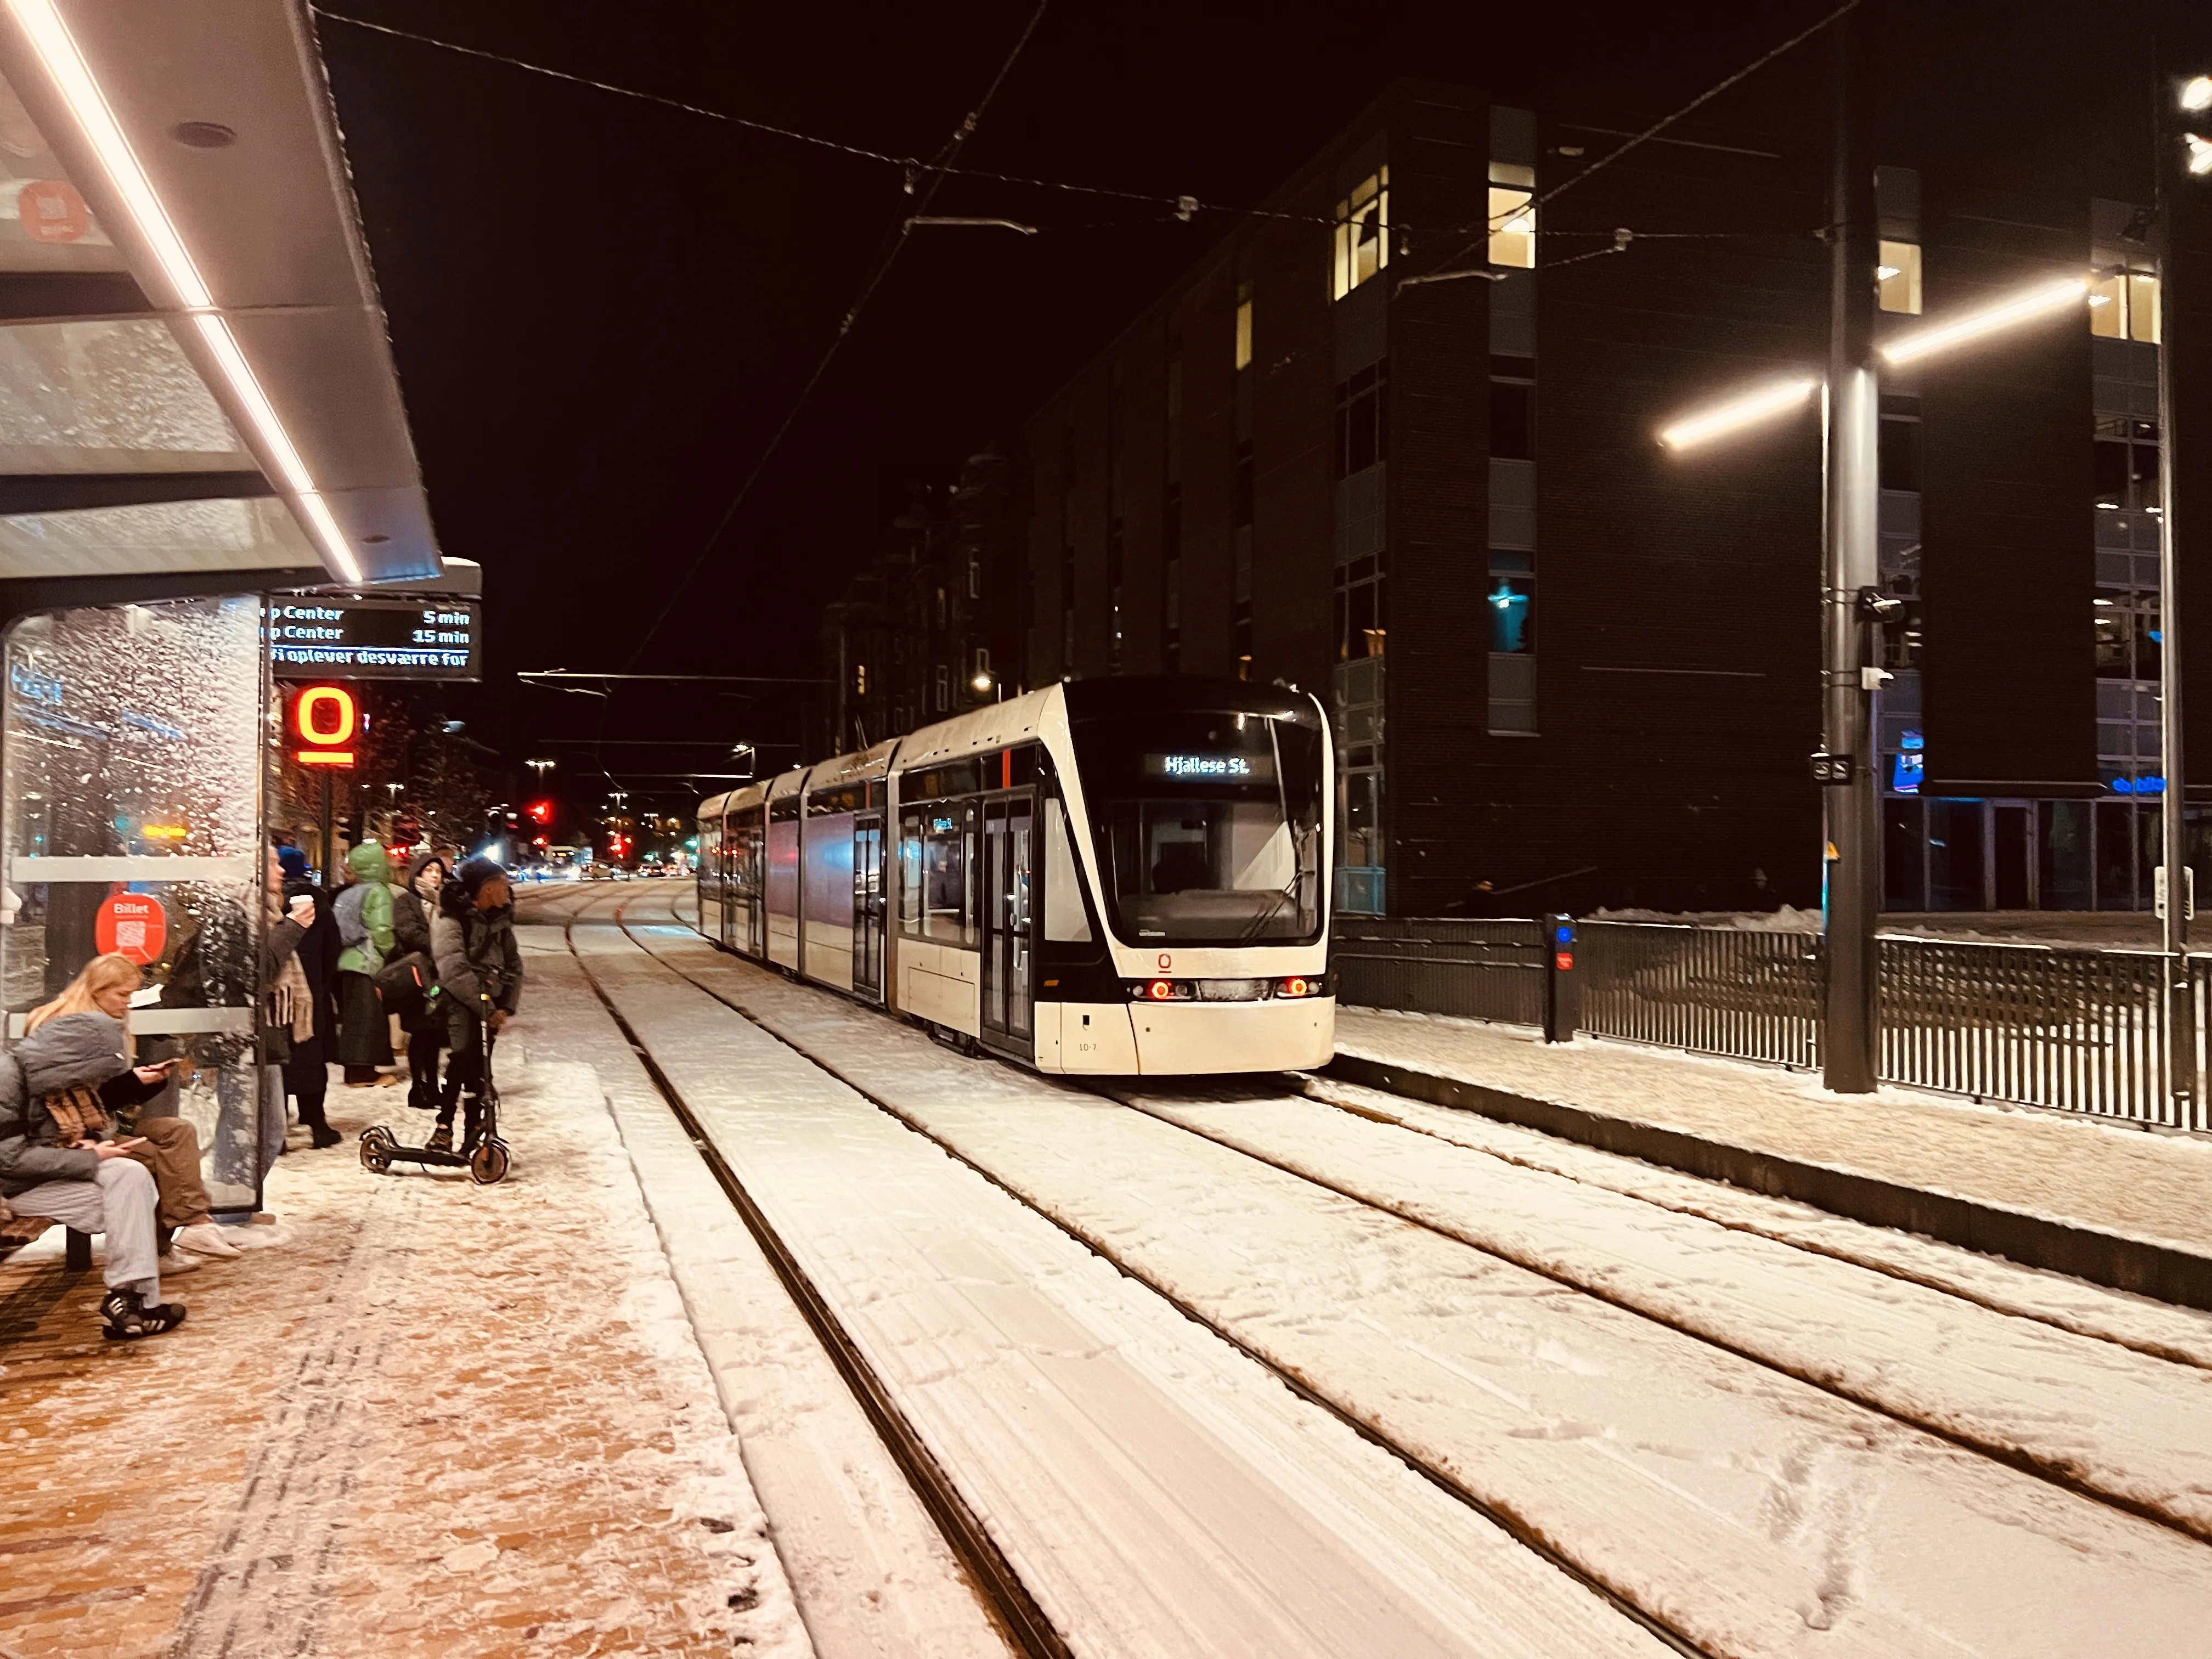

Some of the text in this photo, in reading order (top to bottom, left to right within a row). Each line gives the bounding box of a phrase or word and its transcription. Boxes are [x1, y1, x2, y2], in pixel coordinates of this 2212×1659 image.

[283, 606, 344, 620] Center
[423, 611, 436, 623] 5
[438, 612, 470, 624] min
[284, 625, 343, 640] Center
[413, 630, 436, 642] 15
[438, 631, 469, 644] min
[287, 650, 353, 664] oplever
[357, 651, 438, 665] desværre
[442, 653, 467, 666] for
[1165, 756, 1250, 775] Hjallese St.
[114, 902, 149, 914] Billet
